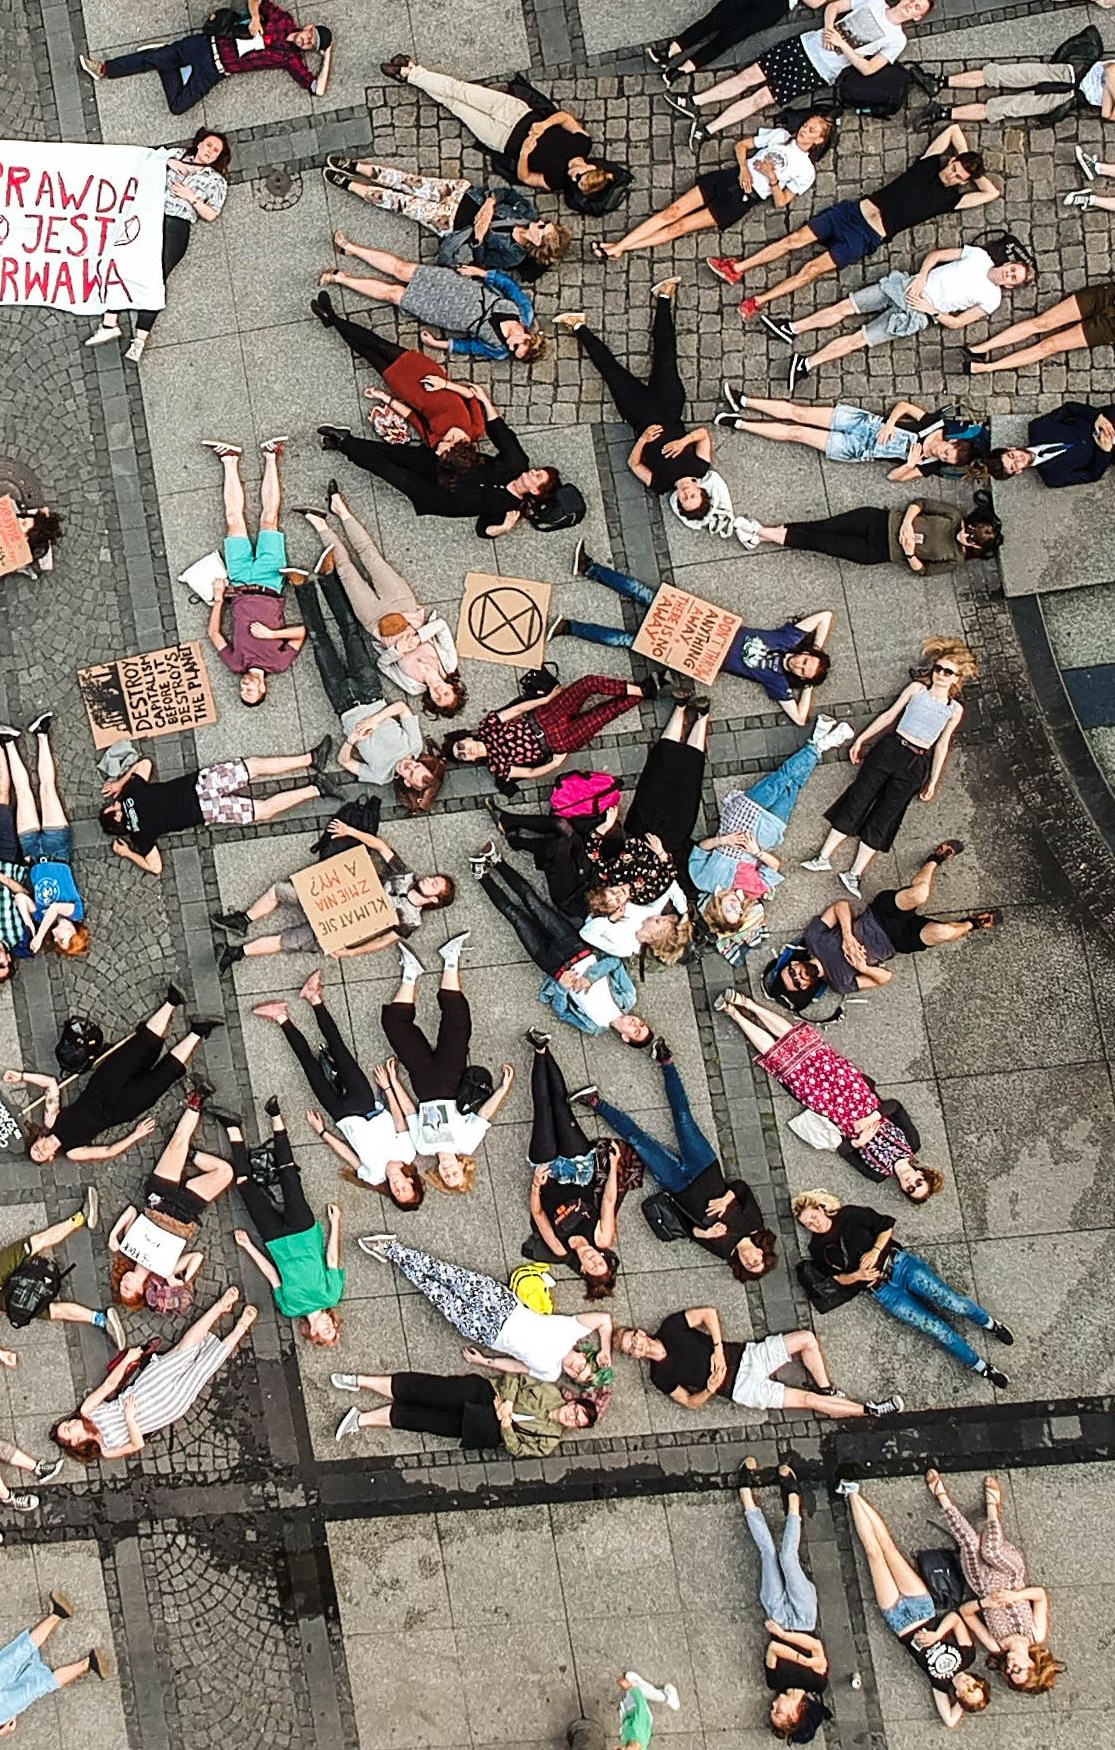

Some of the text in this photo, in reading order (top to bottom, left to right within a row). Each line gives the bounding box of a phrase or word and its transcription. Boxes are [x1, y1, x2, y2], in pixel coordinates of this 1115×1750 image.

[22, 214, 115, 256] JEST
[653, 596, 690, 657] THERE IS NO
[683, 609, 719, 670] ANYTHING
[121, 661, 153, 731] DESTROY
[140, 654, 165, 728] CAPITALISM
[154, 659, 178, 725] BEFORE IT
[165, 652, 192, 725] DESTROYS
[177, 646, 207, 722] THE PLANET
[310, 860, 356, 897] A MY?
[315, 880, 371, 912] ZMIENIA
[338, 897, 388, 928] KLIMAT
